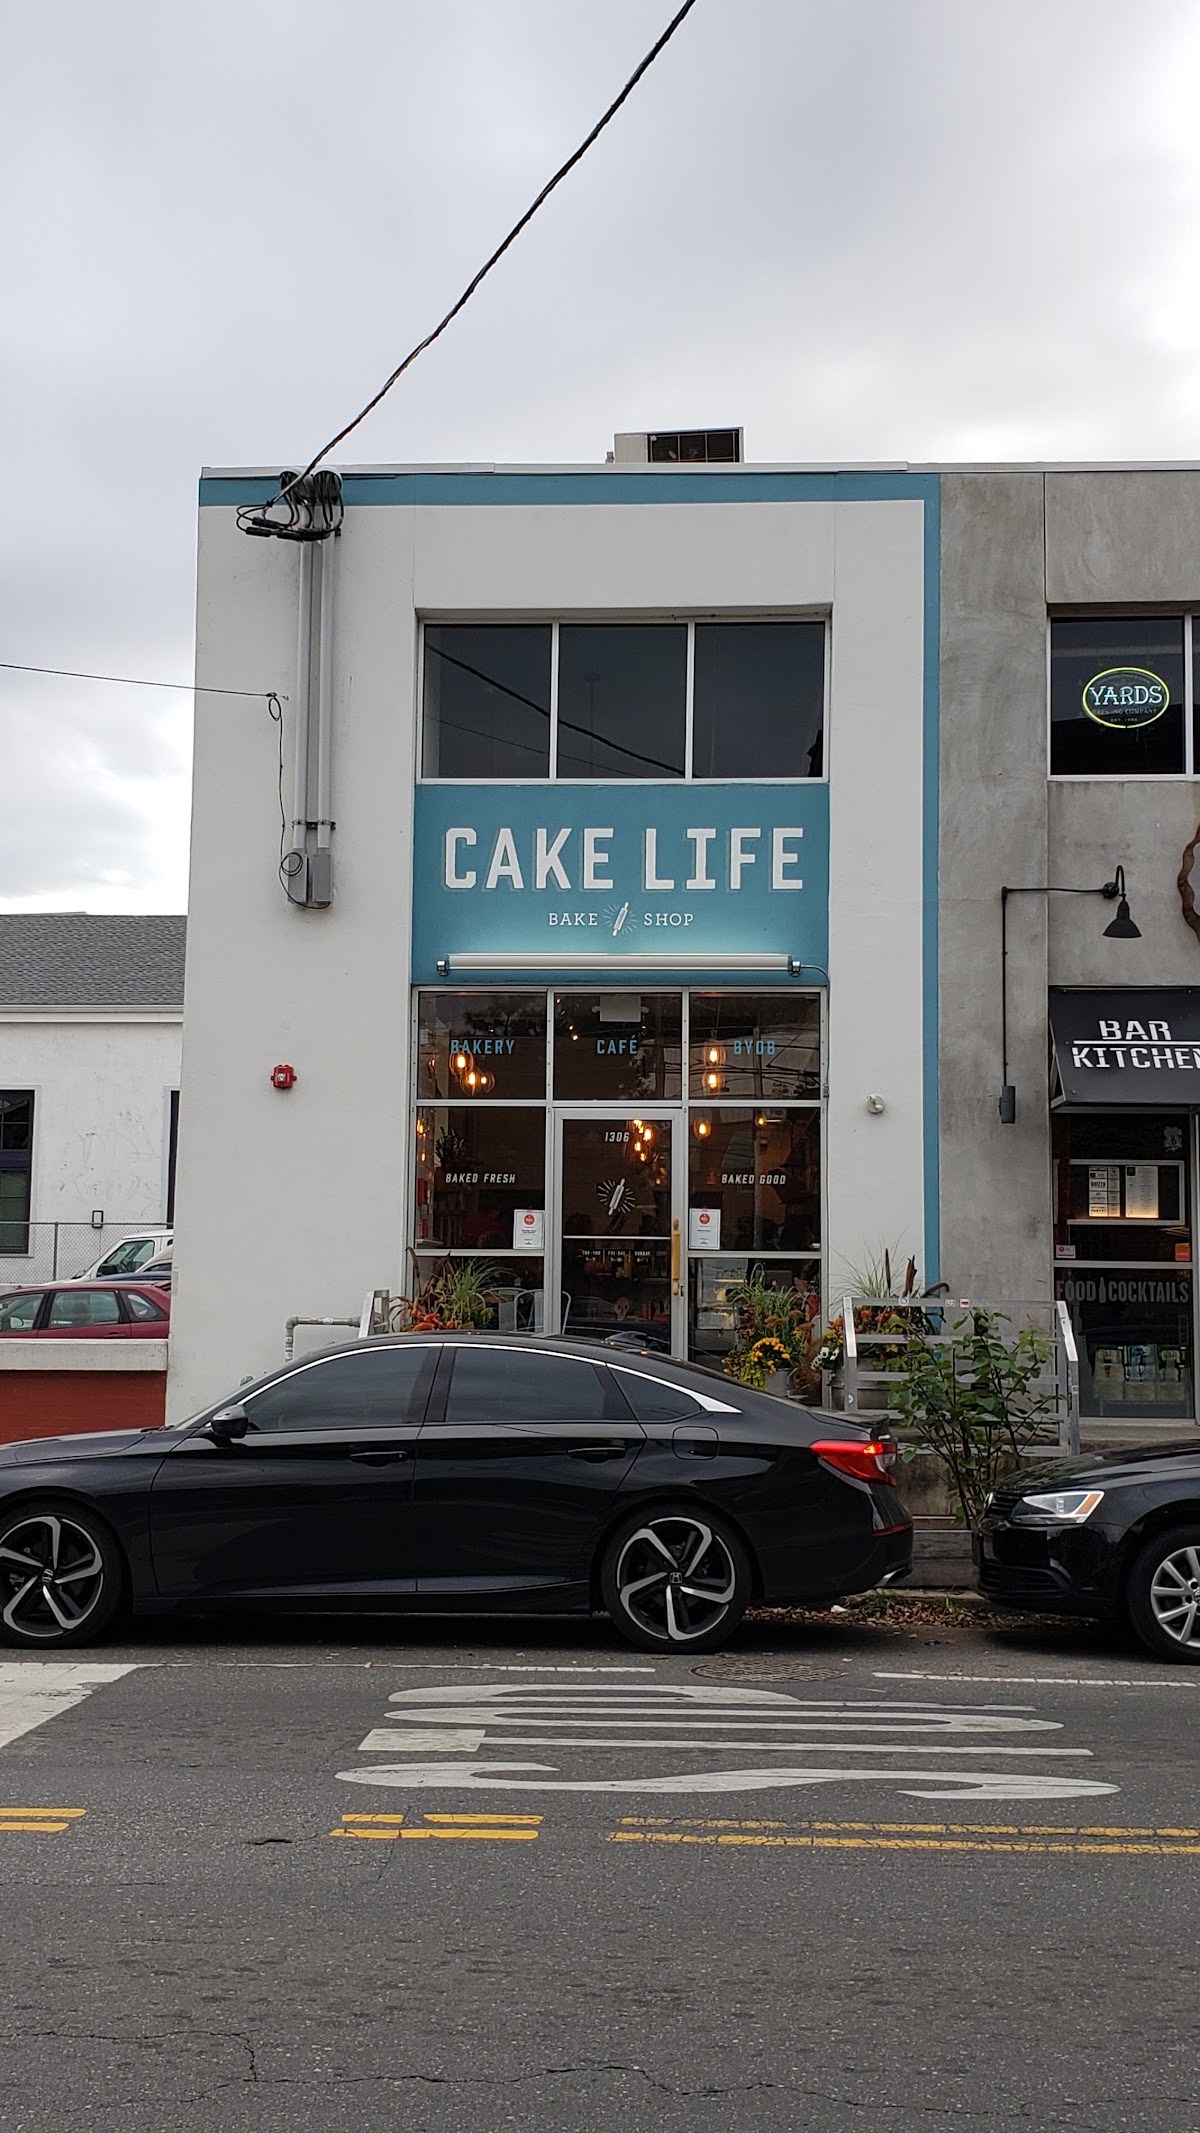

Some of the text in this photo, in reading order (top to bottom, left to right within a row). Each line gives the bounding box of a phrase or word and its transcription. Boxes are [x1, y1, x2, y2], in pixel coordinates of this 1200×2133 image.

[1089, 685, 1163, 706] YARDS
[443, 827, 804, 891] CAKE LIFE
[548, 912, 695, 927] BAKE SHOP
[1099, 1020, 1172, 1040] BAR
[450, 1039, 515, 1055] BAKERY
[596, 1035, 638, 1055] CAFÉ
[733, 1040, 776, 1056] BYOB
[604, 1131, 630, 1143] 1306
[445, 1173, 516, 1184] BAKED FRESH
[721, 1173, 787, 1185] BAKED GOOD
[1055, 1280, 1190, 1303] FOOD COCKTAILS
